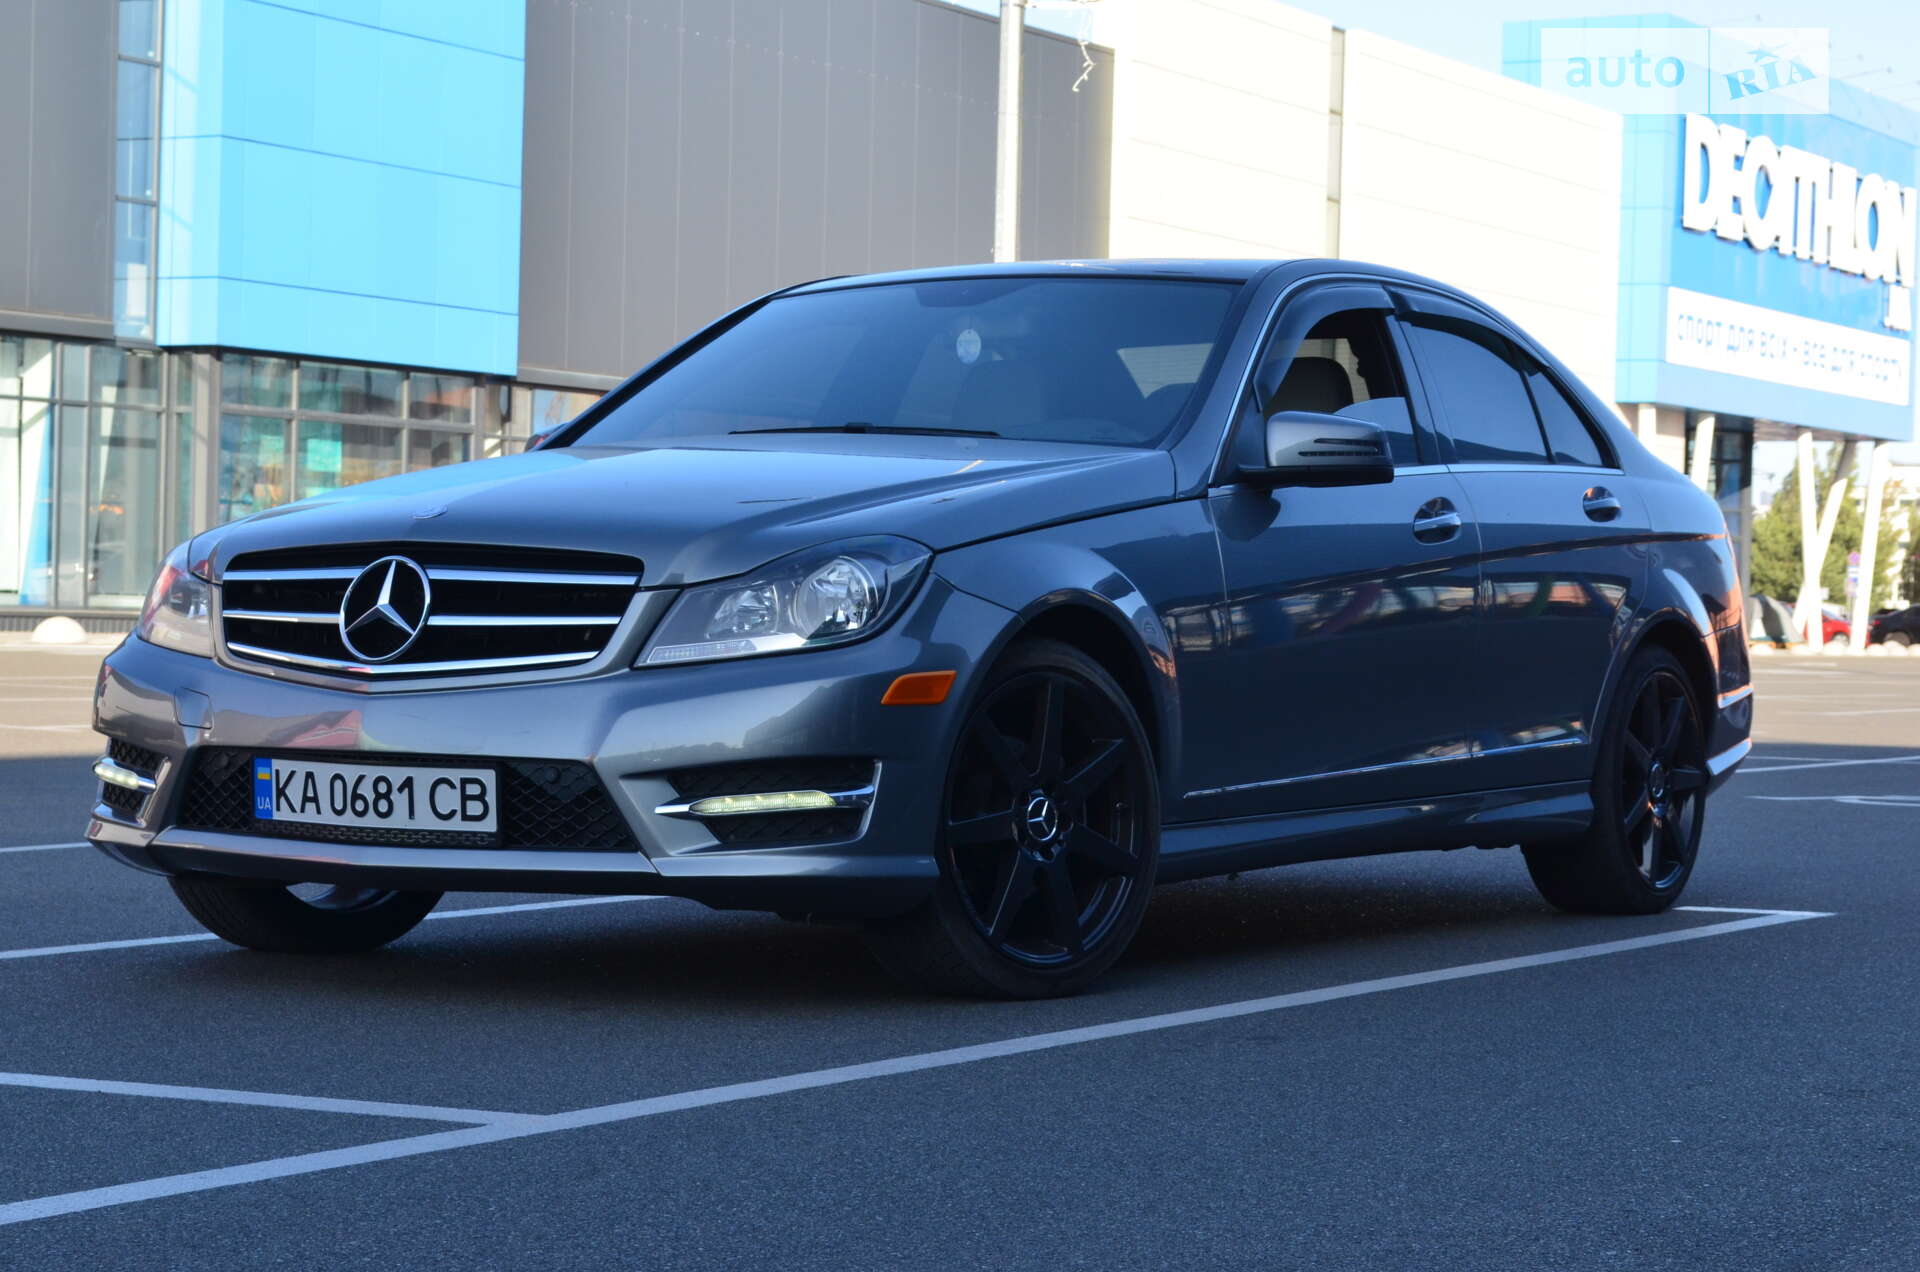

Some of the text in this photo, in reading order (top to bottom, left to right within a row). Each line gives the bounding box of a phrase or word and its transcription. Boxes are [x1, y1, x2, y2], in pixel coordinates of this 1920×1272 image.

[1681, 112, 1918, 289] DECATHLON
[257, 796, 272, 811] UA
[274, 768, 490, 822] KA 0681 CB
